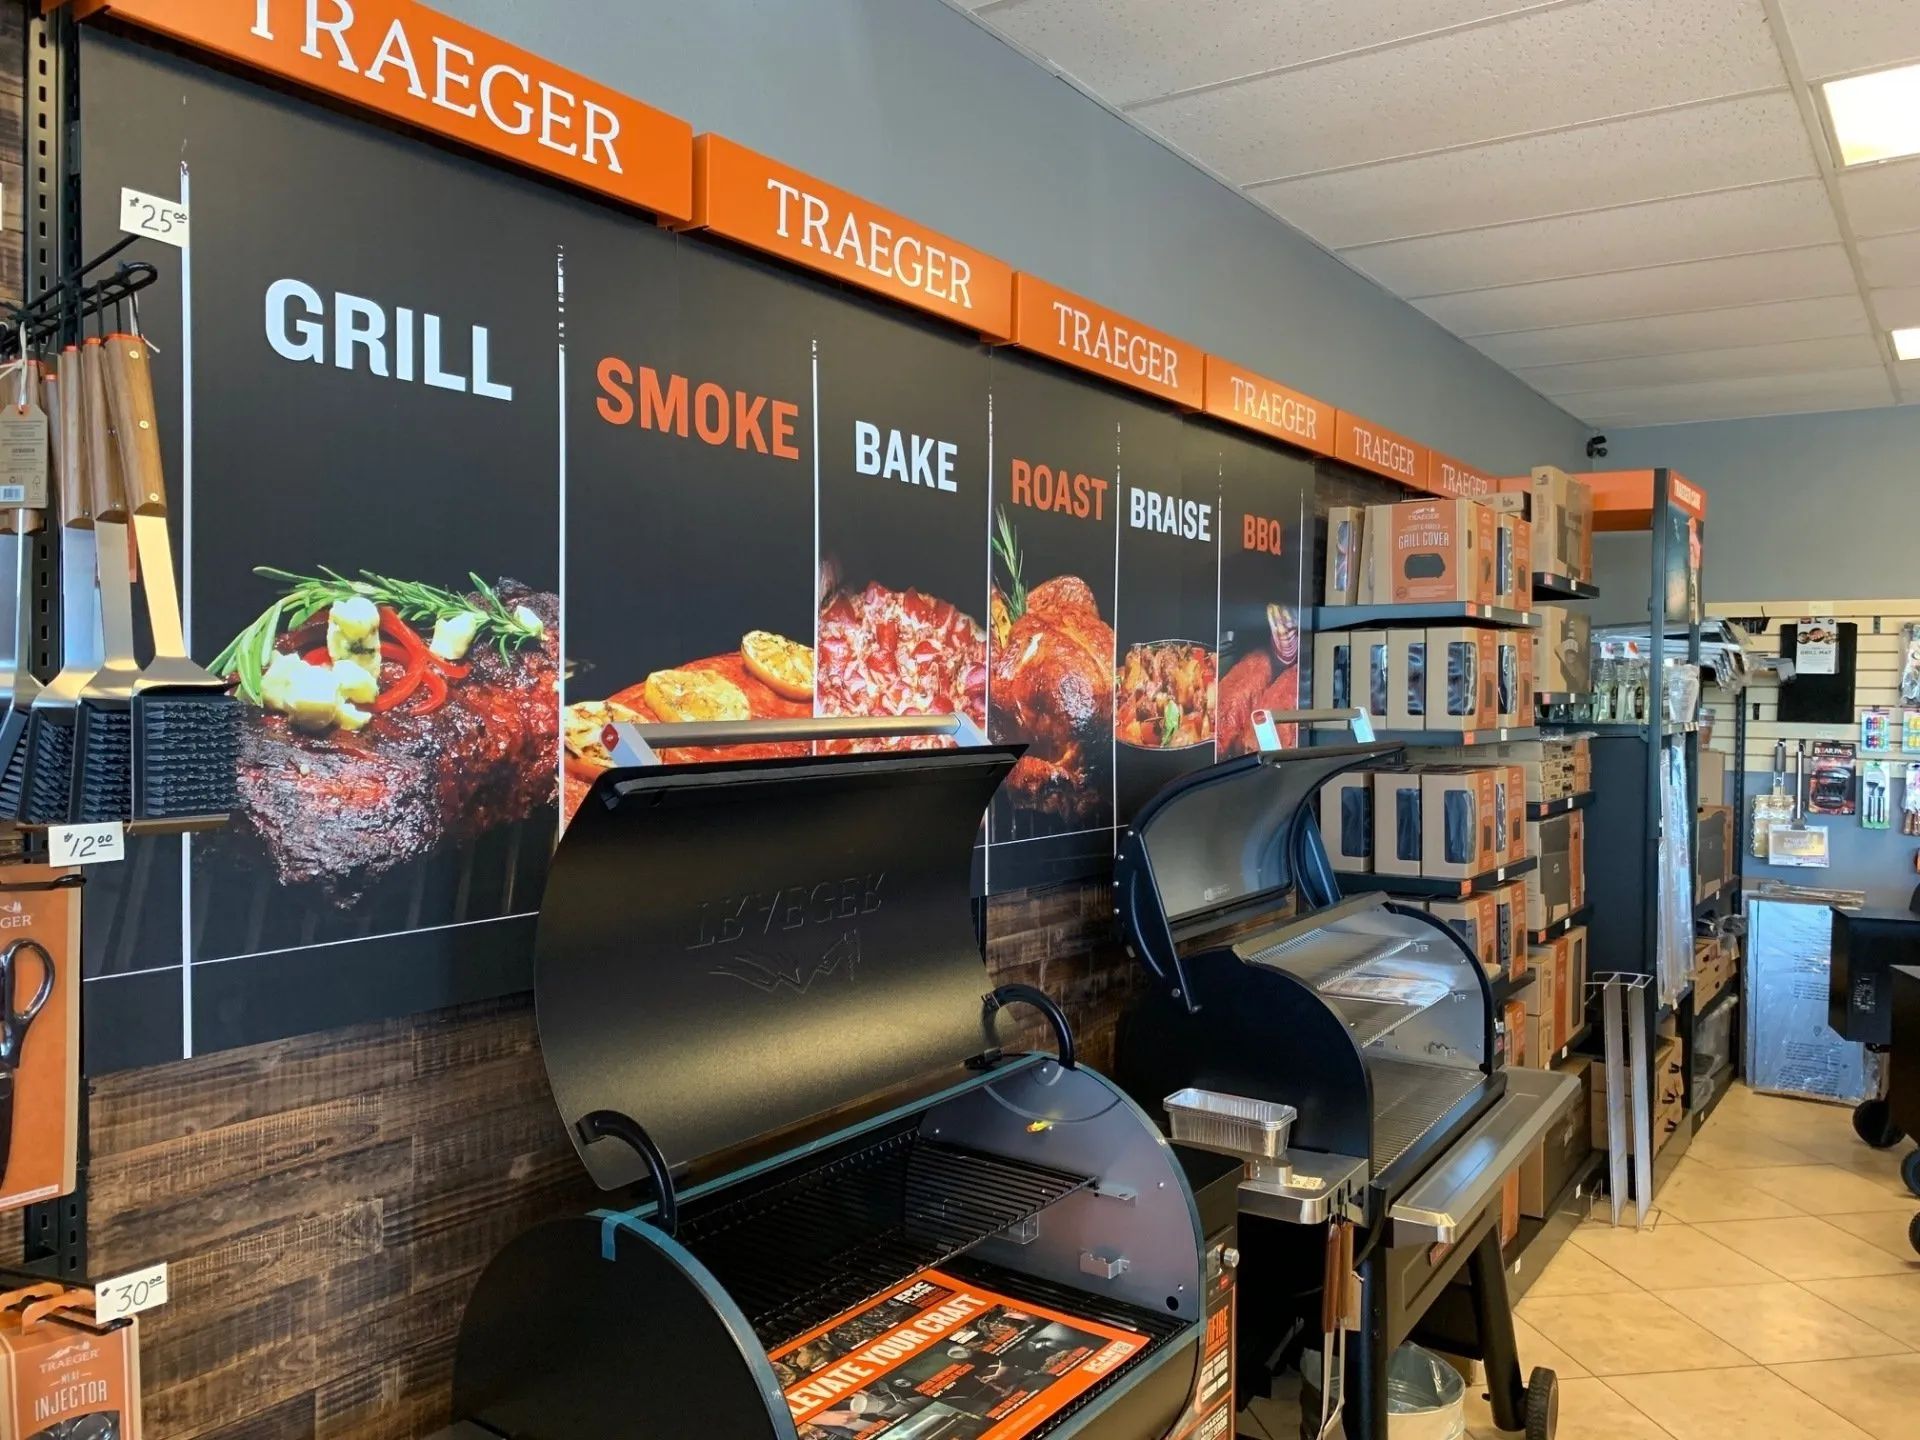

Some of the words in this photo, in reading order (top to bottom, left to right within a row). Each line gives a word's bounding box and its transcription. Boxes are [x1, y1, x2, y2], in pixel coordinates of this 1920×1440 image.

[767, 178, 973, 309] TRAEGER
[264, 277, 513, 402] GRILL
[1052, 301, 1179, 389] TRAEGER
[595, 356, 801, 461] SMOKE
[1230, 376, 1318, 440] TRAEGER
[855, 420, 958, 493] BAKE
[1352, 426, 1415, 477] TRAEGER
[1441, 463, 1488, 498] TRAEGER
[1010, 457, 1109, 521] ROAST
[1130, 486, 1212, 543] BRAISE
[1242, 512, 1281, 556] BBQ
[1398, 533, 1420, 550] GRILL
[1422, 531, 1450, 547] COVER
[39, 1348, 101, 1374] TRAEGER
[786, 1361, 876, 1419] LEVATE
[856, 1329, 931, 1367] YOUR
[913, 1293, 987, 1333] CRAFT
[34, 1379, 108, 1422] INJECTOR
